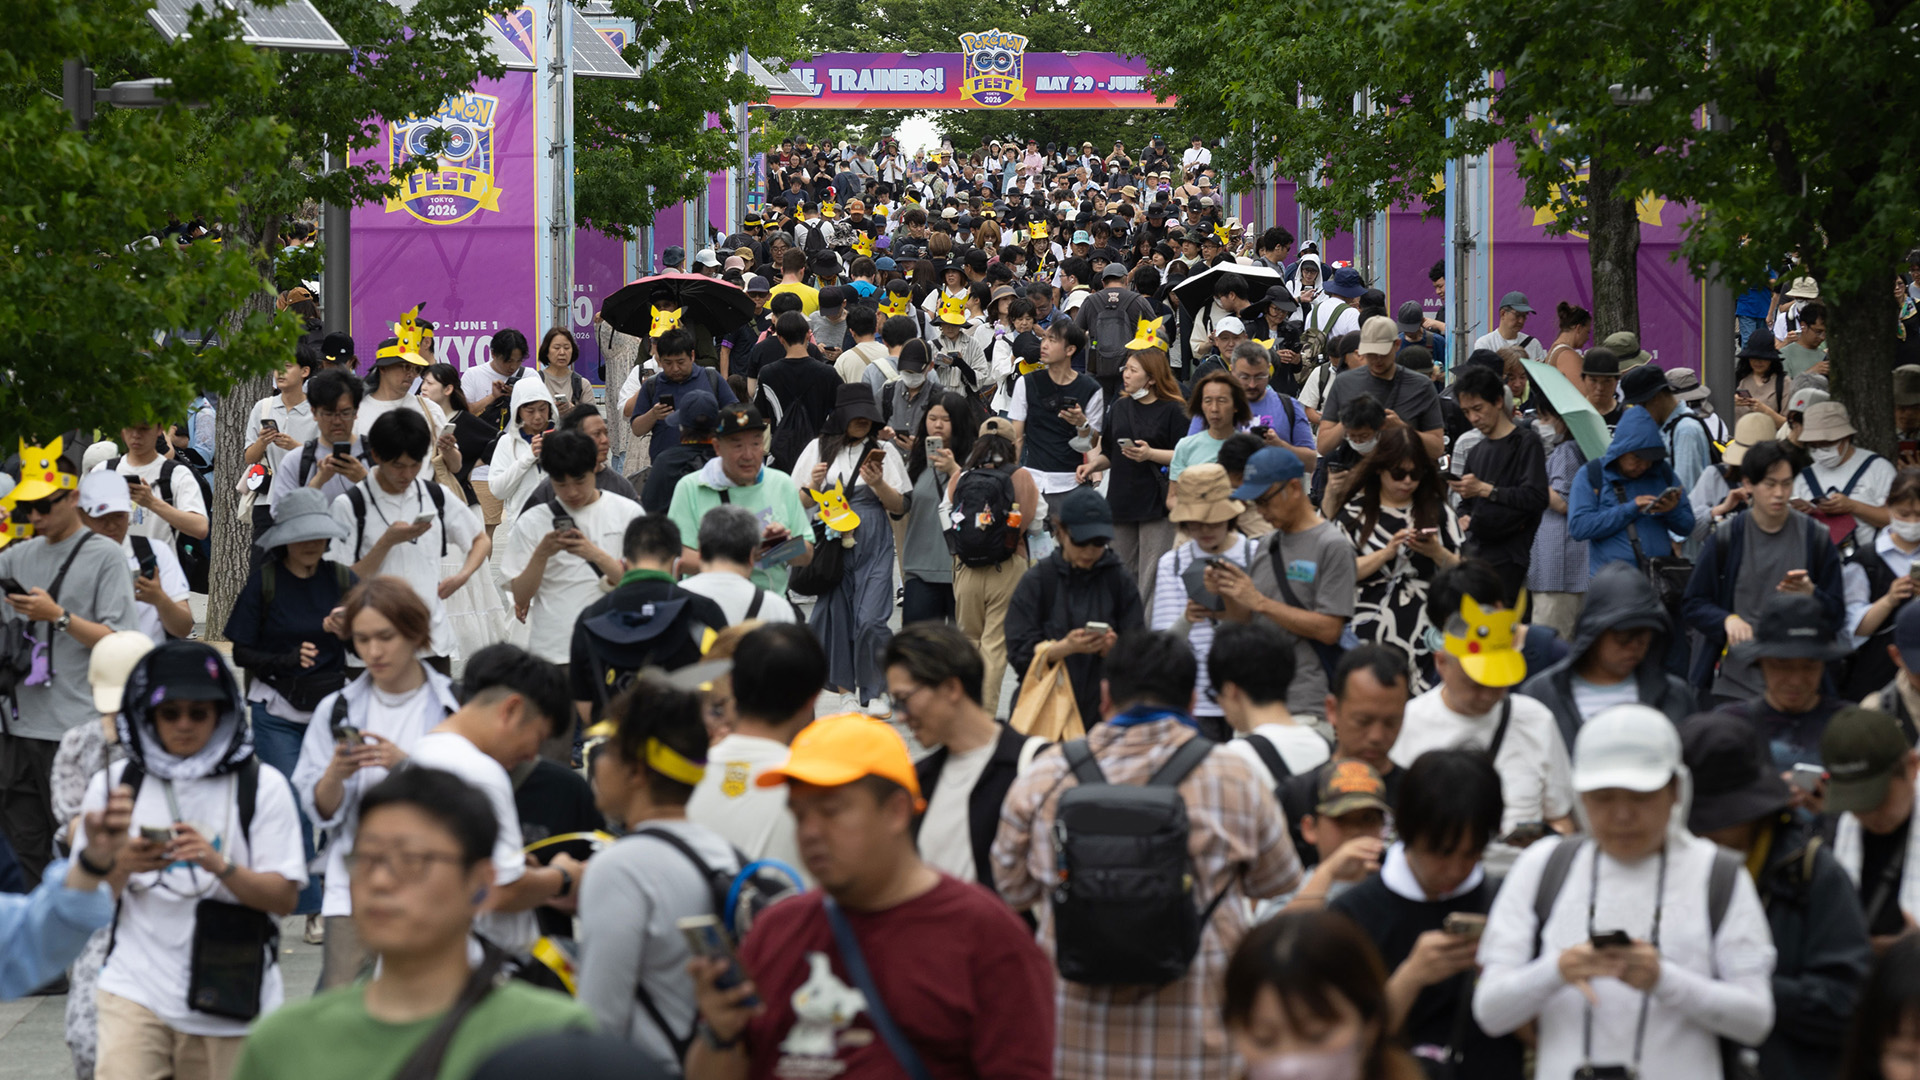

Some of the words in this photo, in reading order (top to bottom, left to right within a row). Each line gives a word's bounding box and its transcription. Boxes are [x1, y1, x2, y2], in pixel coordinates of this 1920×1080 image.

[976, 51, 1012, 70] GO
[828, 68, 944, 91] TRAINERS!
[974, 77, 1013, 90] FEST
[1035, 76, 1070, 91] MAY
[1073, 76, 1094, 91] 29
[408, 171, 477, 195] FEST
[427, 204, 458, 216] 2026
[1424, 299, 1443, 307] MA
[432, 321, 440, 330] 9
[453, 321, 487, 331] JUNE
[492, 321, 498, 330] 1
